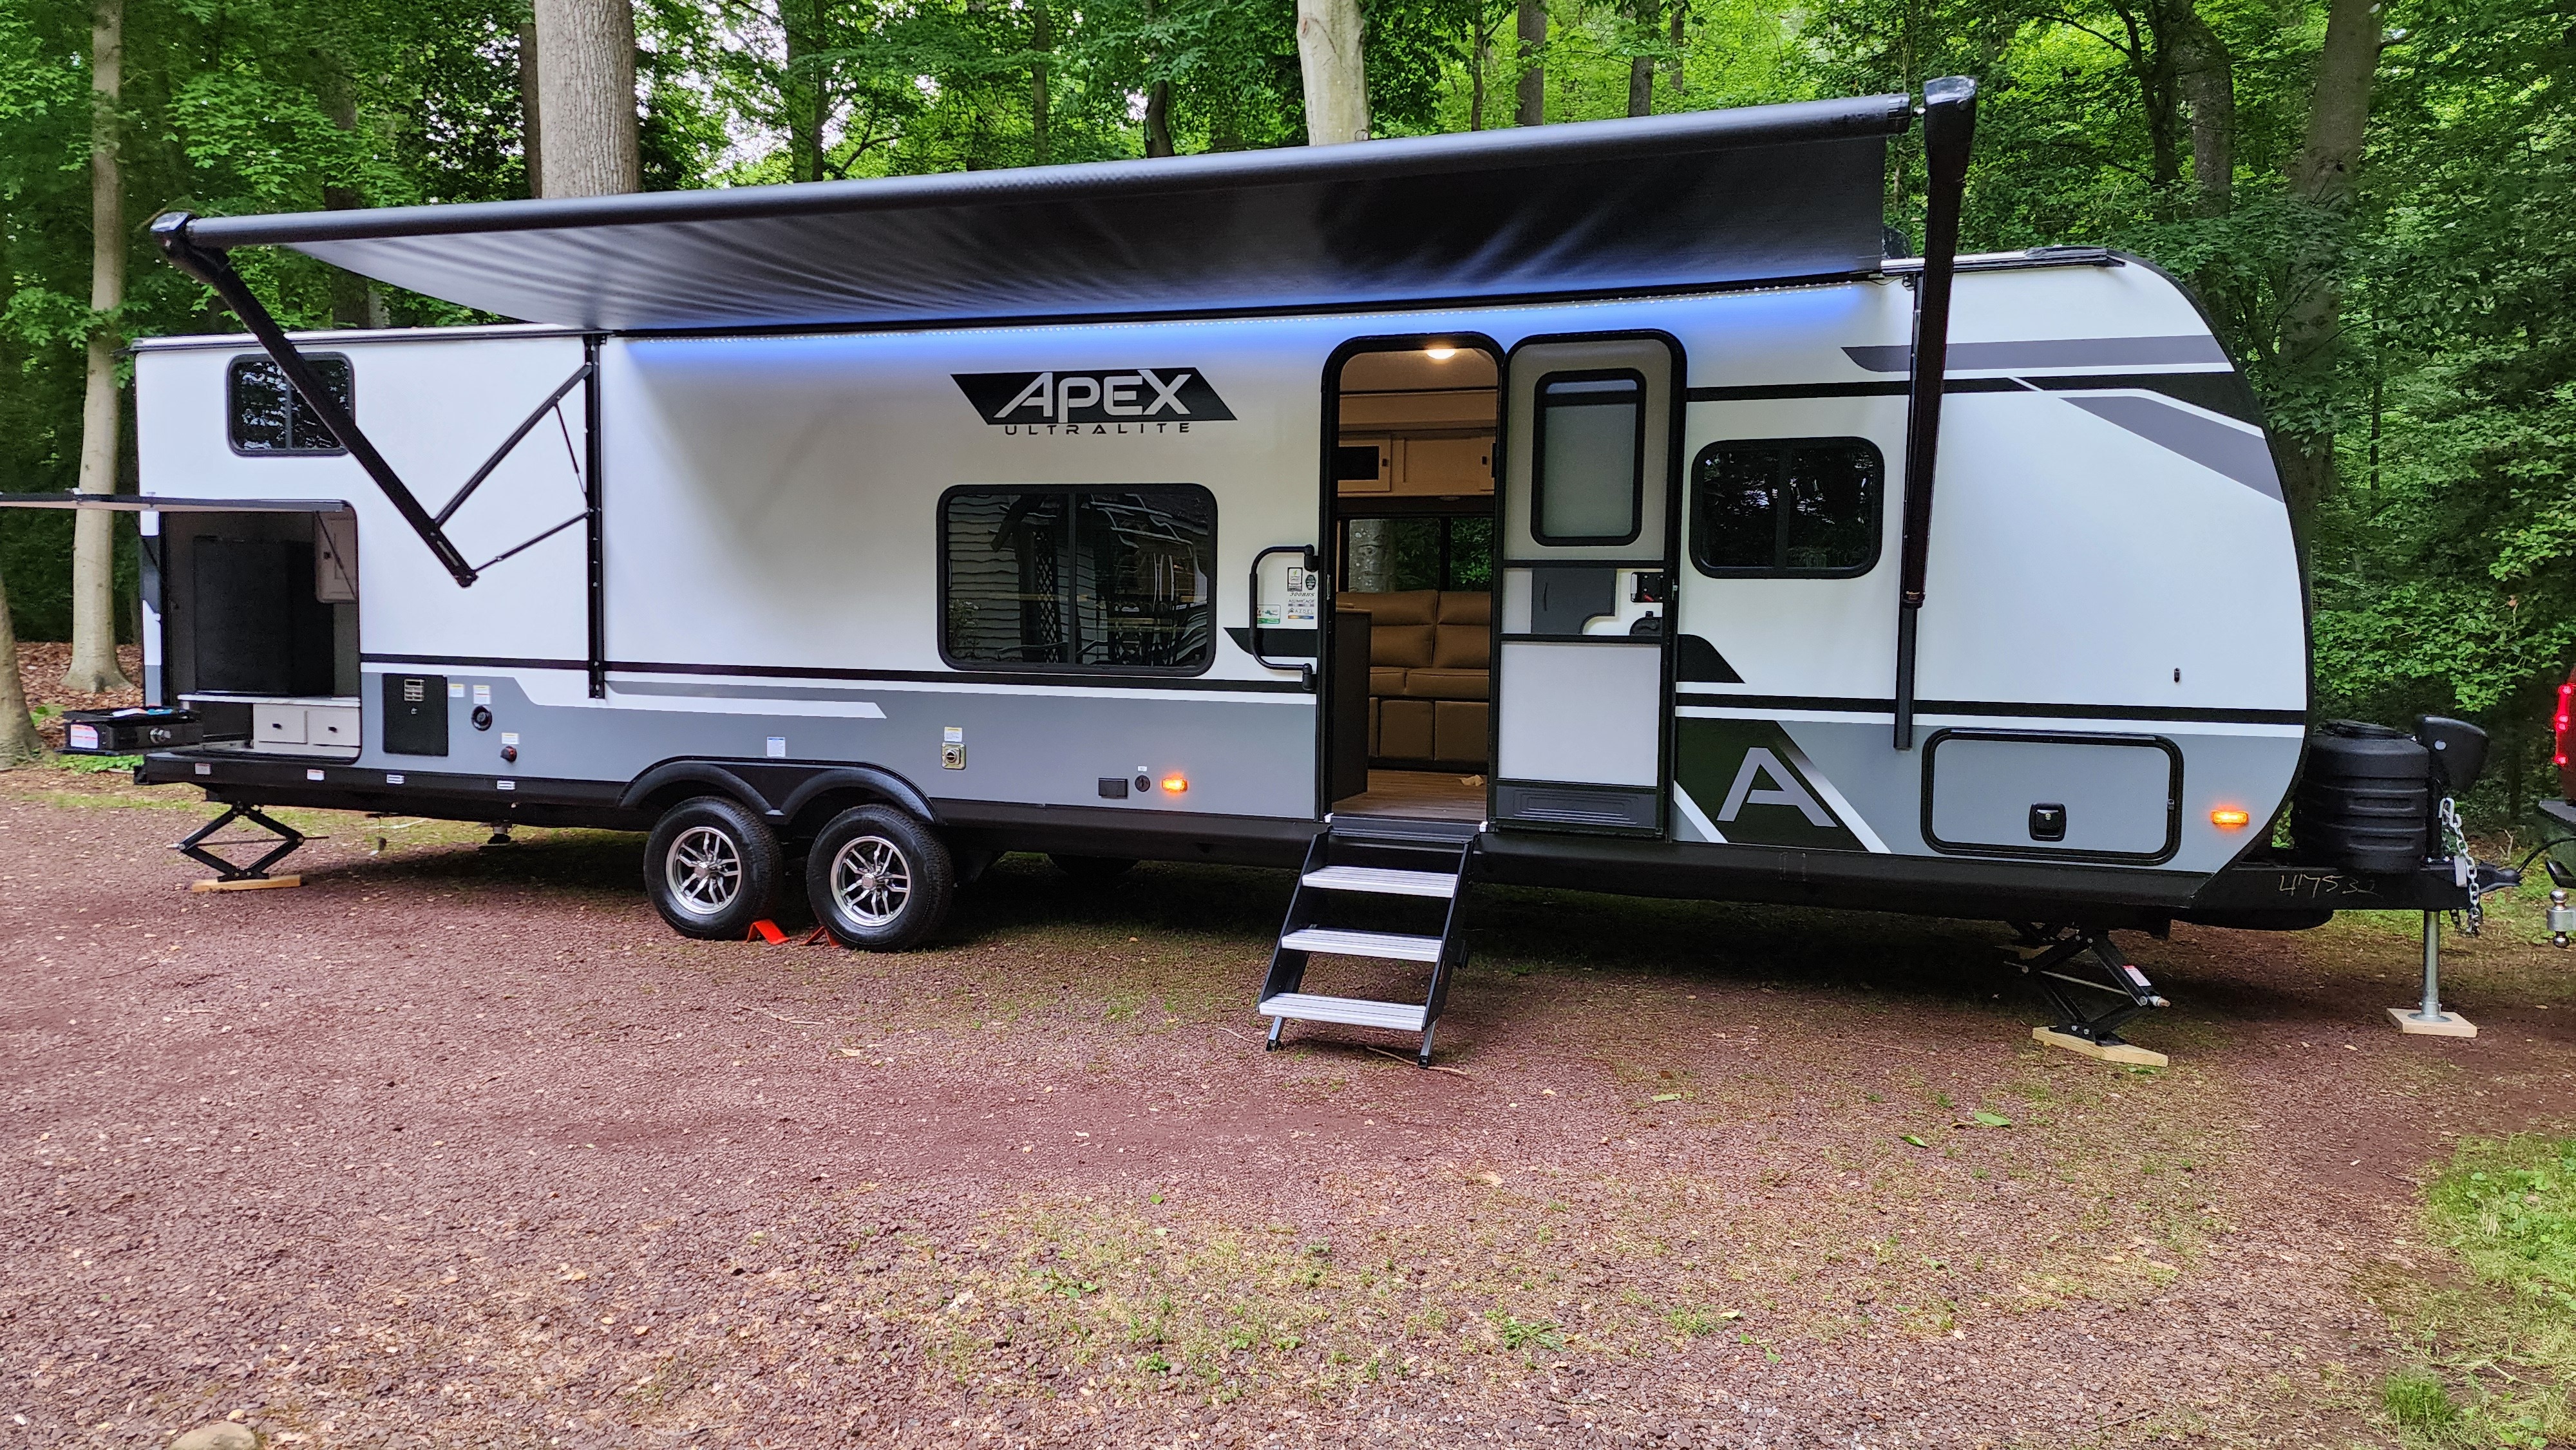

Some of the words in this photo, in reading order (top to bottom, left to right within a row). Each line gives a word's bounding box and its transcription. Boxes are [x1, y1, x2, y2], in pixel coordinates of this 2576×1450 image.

[993, 369, 1191, 423] APEX
[1005, 422, 1190, 435] ULTRALITE
[1716, 747, 1839, 827] A
